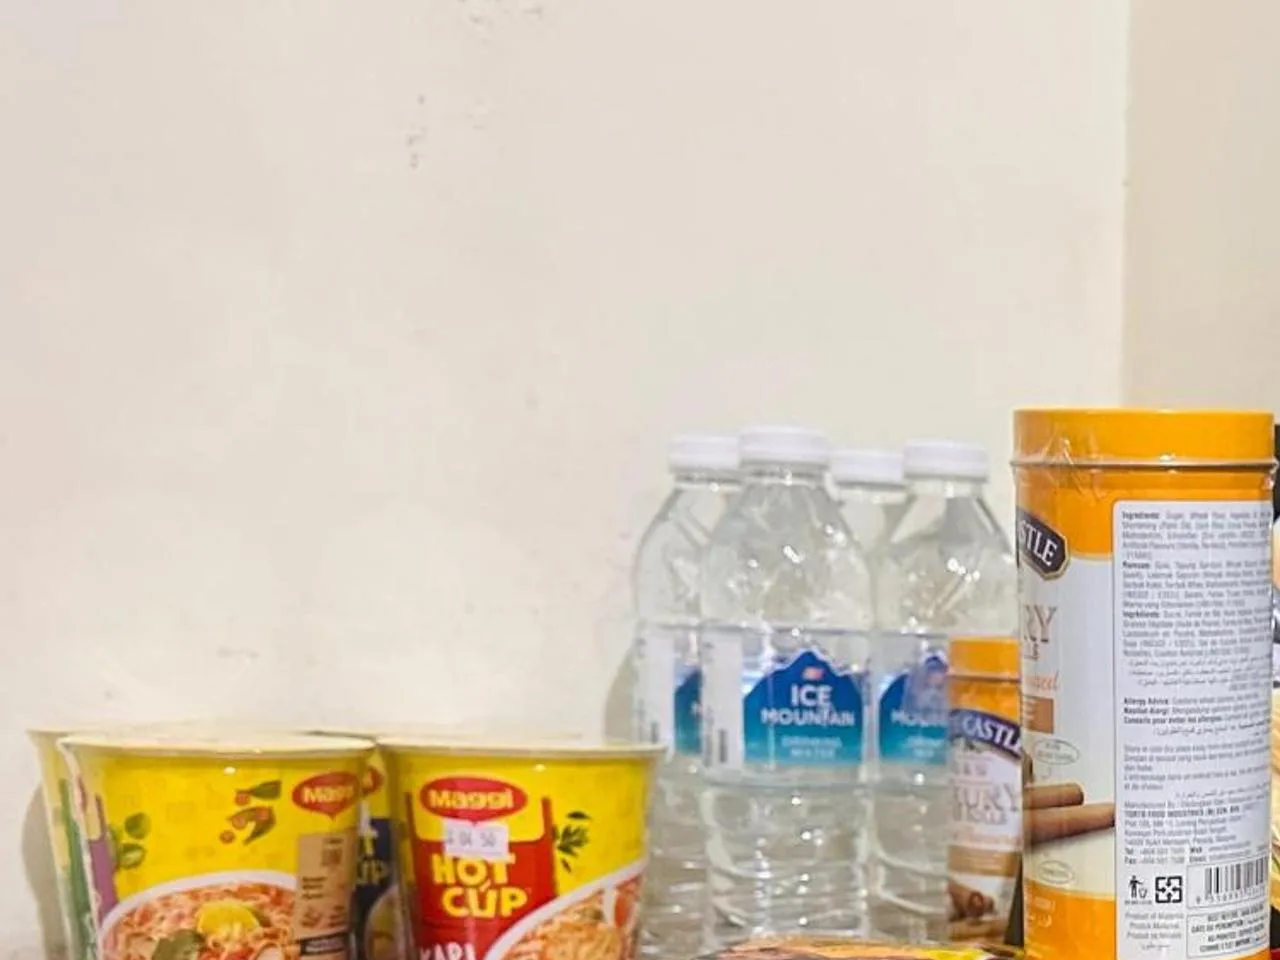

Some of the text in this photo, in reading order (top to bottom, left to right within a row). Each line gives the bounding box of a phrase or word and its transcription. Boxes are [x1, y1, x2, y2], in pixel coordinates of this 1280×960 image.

[1018, 518, 1058, 567] STLE
[791, 683, 833, 707] ICE
[428, 788, 515, 810] Maggi
[431, 852, 517, 886] HOT
[441, 879, 529, 918] CUP
